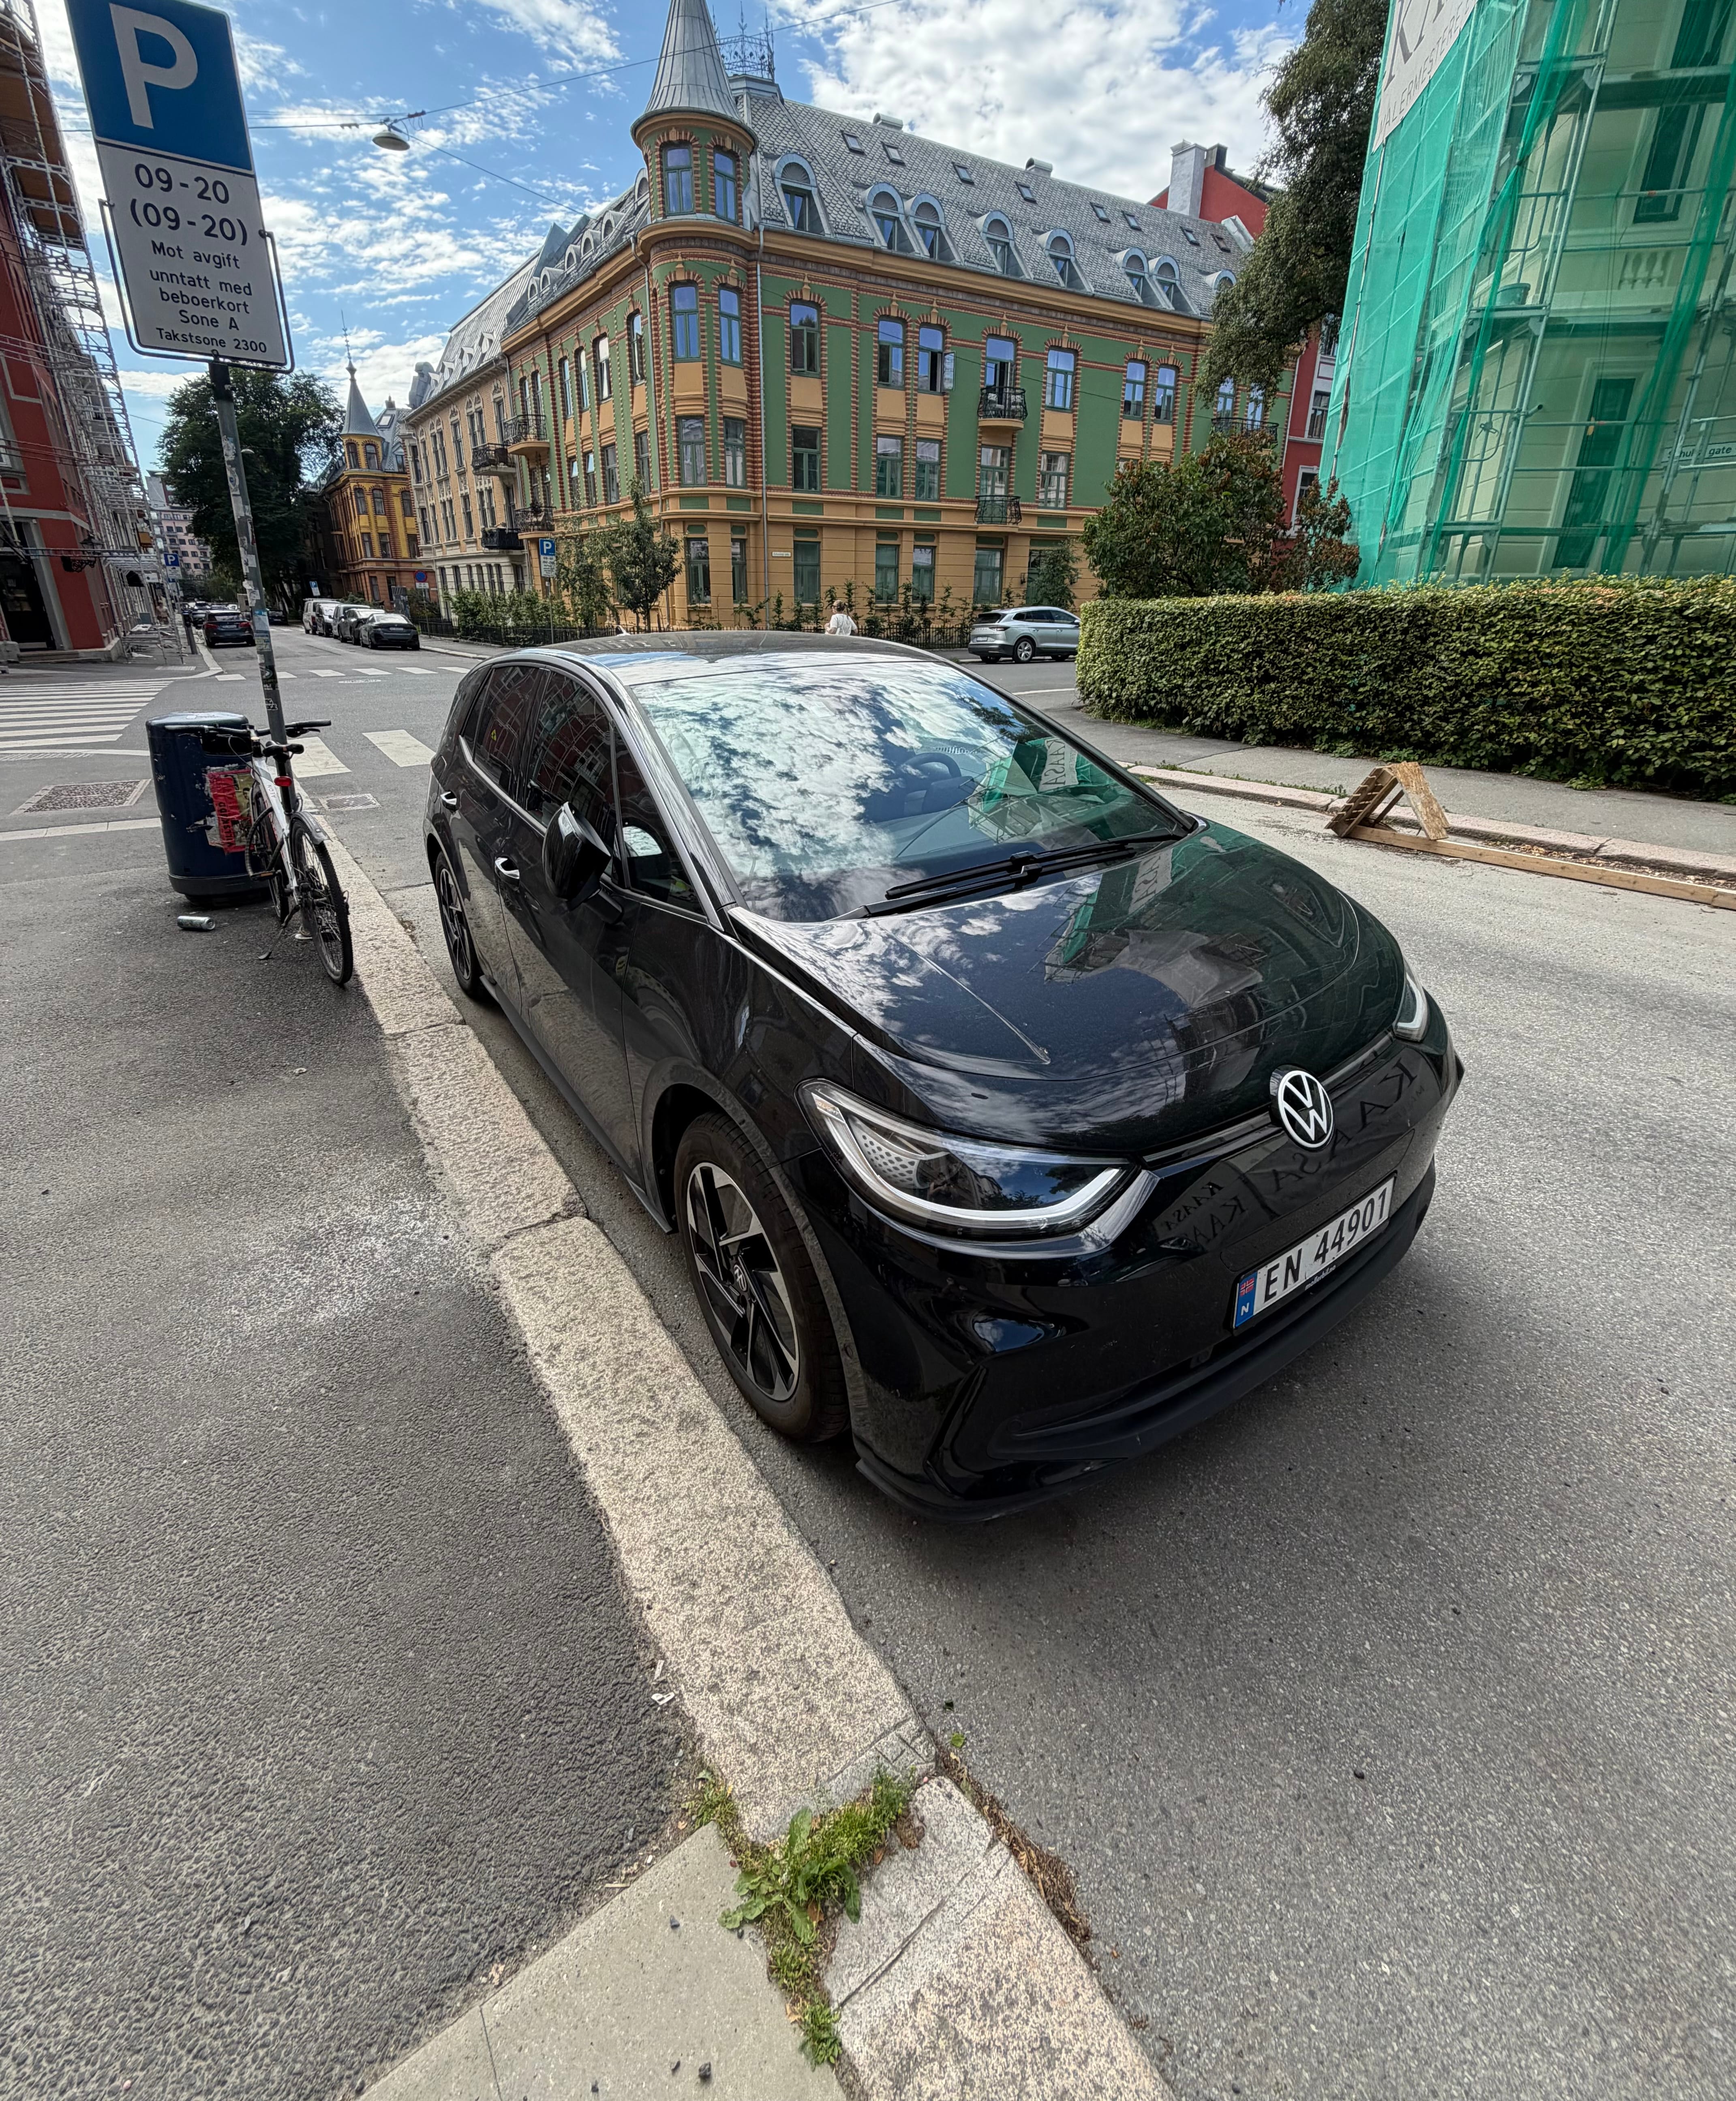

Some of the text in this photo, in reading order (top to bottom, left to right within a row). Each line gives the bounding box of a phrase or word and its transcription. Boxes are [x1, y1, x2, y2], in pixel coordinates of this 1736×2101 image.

[109, 3, 197, 128] P
[135, 163, 229, 204] 09-20
[130, 198, 248, 246] (09-20)
[151, 240, 240, 270] Mot avgift
[149, 269, 253, 296] unntatt med
[159, 287, 250, 314] beboerkort
[178, 309, 240, 331] Sone A
[155, 327, 267, 353] Takstsone 2300
[1708, 446, 1732, 457] gate
[167, 555, 176, 565] P
[544, 541, 552, 554] P
[1281, 1072, 1330, 1145] VW
[1264, 1187, 1387, 1303] EN 44901
[1241, 1303, 1250, 1316] N
